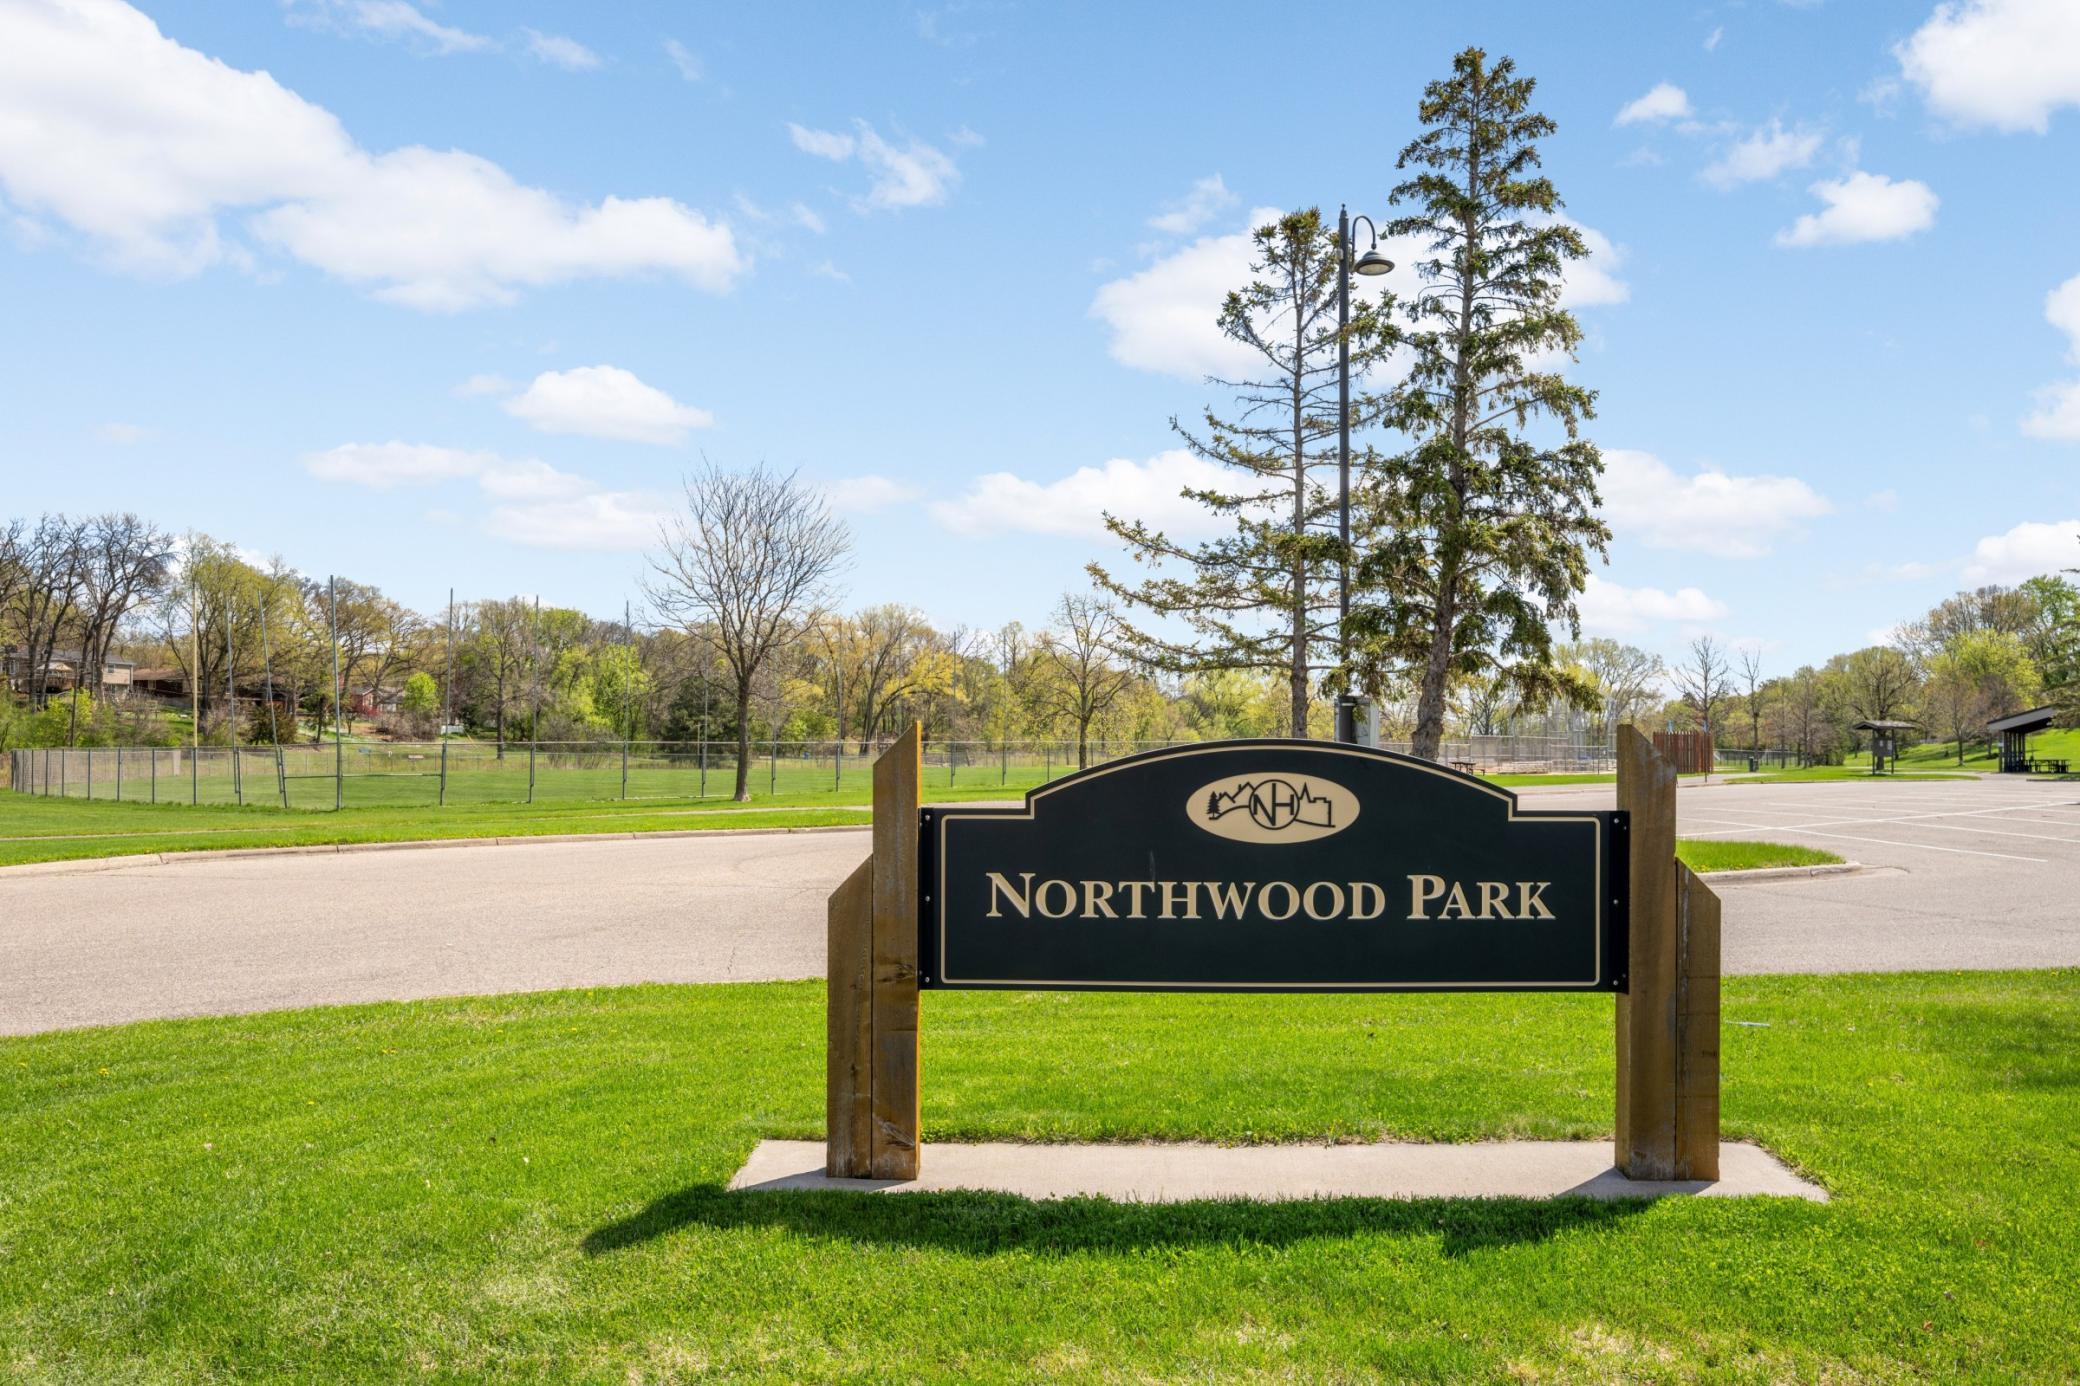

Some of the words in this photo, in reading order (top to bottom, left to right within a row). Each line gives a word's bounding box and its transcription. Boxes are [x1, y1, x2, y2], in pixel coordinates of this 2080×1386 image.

[1253, 783, 1295, 826] NH
[985, 872, 1386, 920] NORTHWOOD
[1406, 874, 1556, 919] PARK
